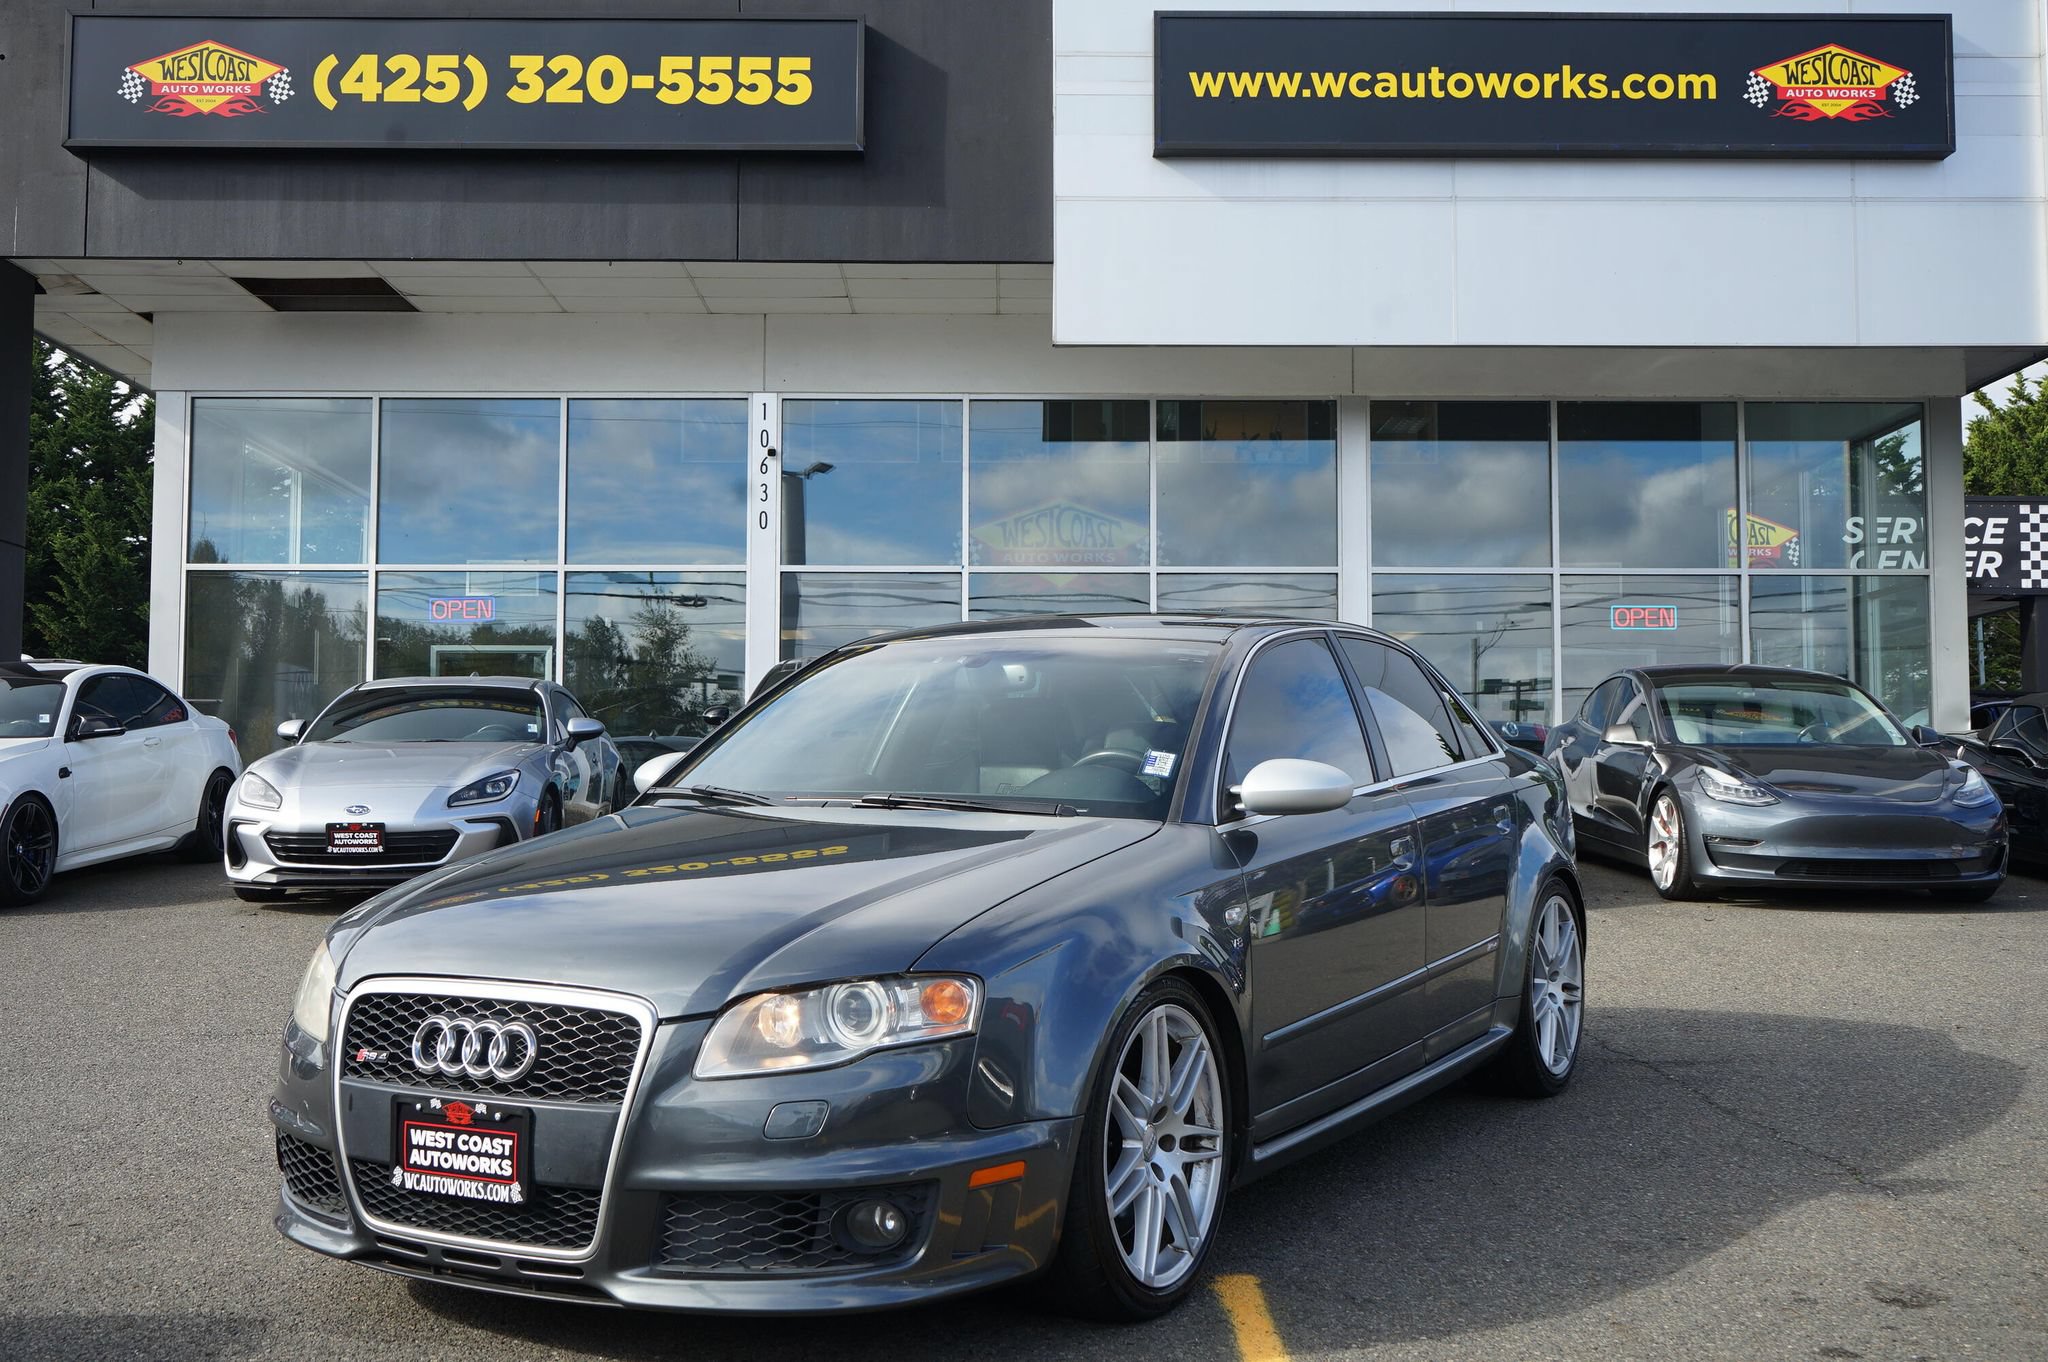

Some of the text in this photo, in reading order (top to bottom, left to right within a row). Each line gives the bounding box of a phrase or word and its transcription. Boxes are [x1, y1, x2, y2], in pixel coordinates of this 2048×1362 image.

[161, 85, 252, 94] AUTO WORKS
[312, 53, 813, 112] (425) 320-5555
[1189, 64, 1717, 100] www.wcautoworks.com
[1786, 89, 1877, 98] AUTO WORKS
[1003, 552, 1116, 563] AUTO WORKS
[432, 599, 492, 620] OPEN
[1615, 607, 1674, 627] OPEN
[410, 1128, 513, 1156] WEST COAST
[409, 1148, 513, 1176] AUTOWORKS
[403, 1172, 510, 1203] WCAUTOWORKS.COM
